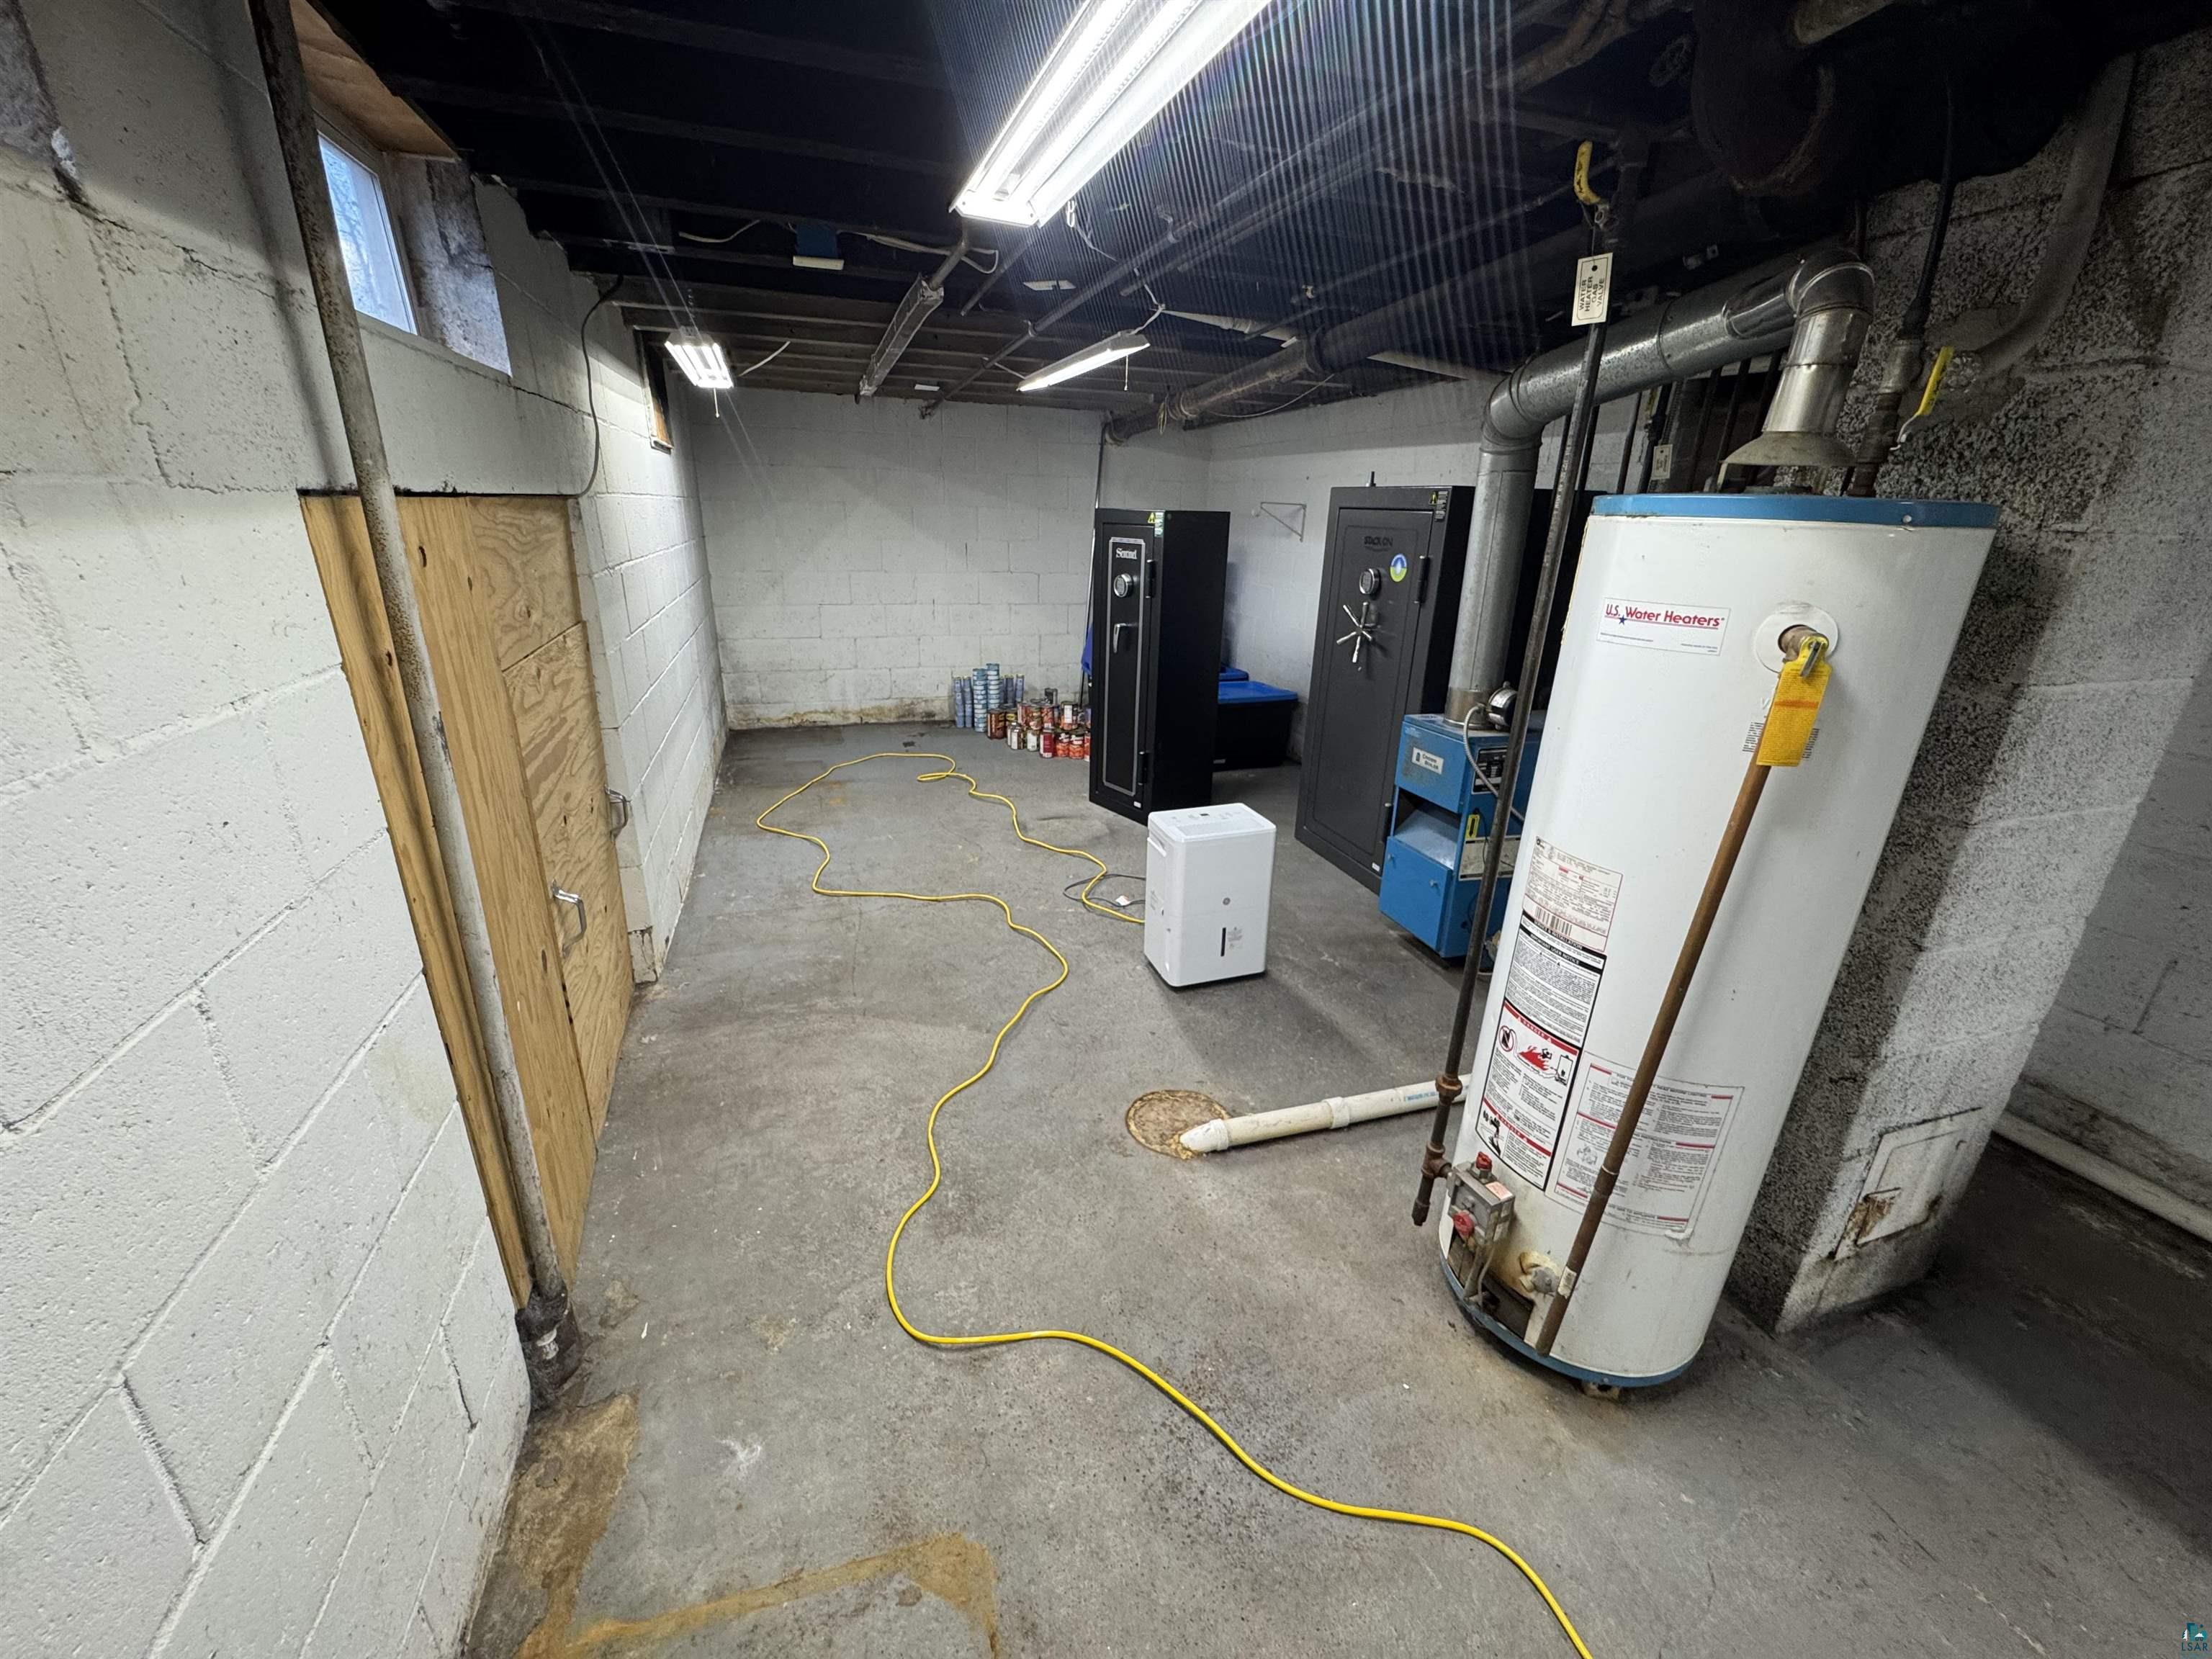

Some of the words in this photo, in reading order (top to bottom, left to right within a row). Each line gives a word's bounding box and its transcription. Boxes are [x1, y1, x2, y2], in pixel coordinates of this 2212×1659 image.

[1596, 278, 1605, 307] VALVE
[1606, 603, 1621, 617] U.S.
[1625, 606, 1661, 621] Water
